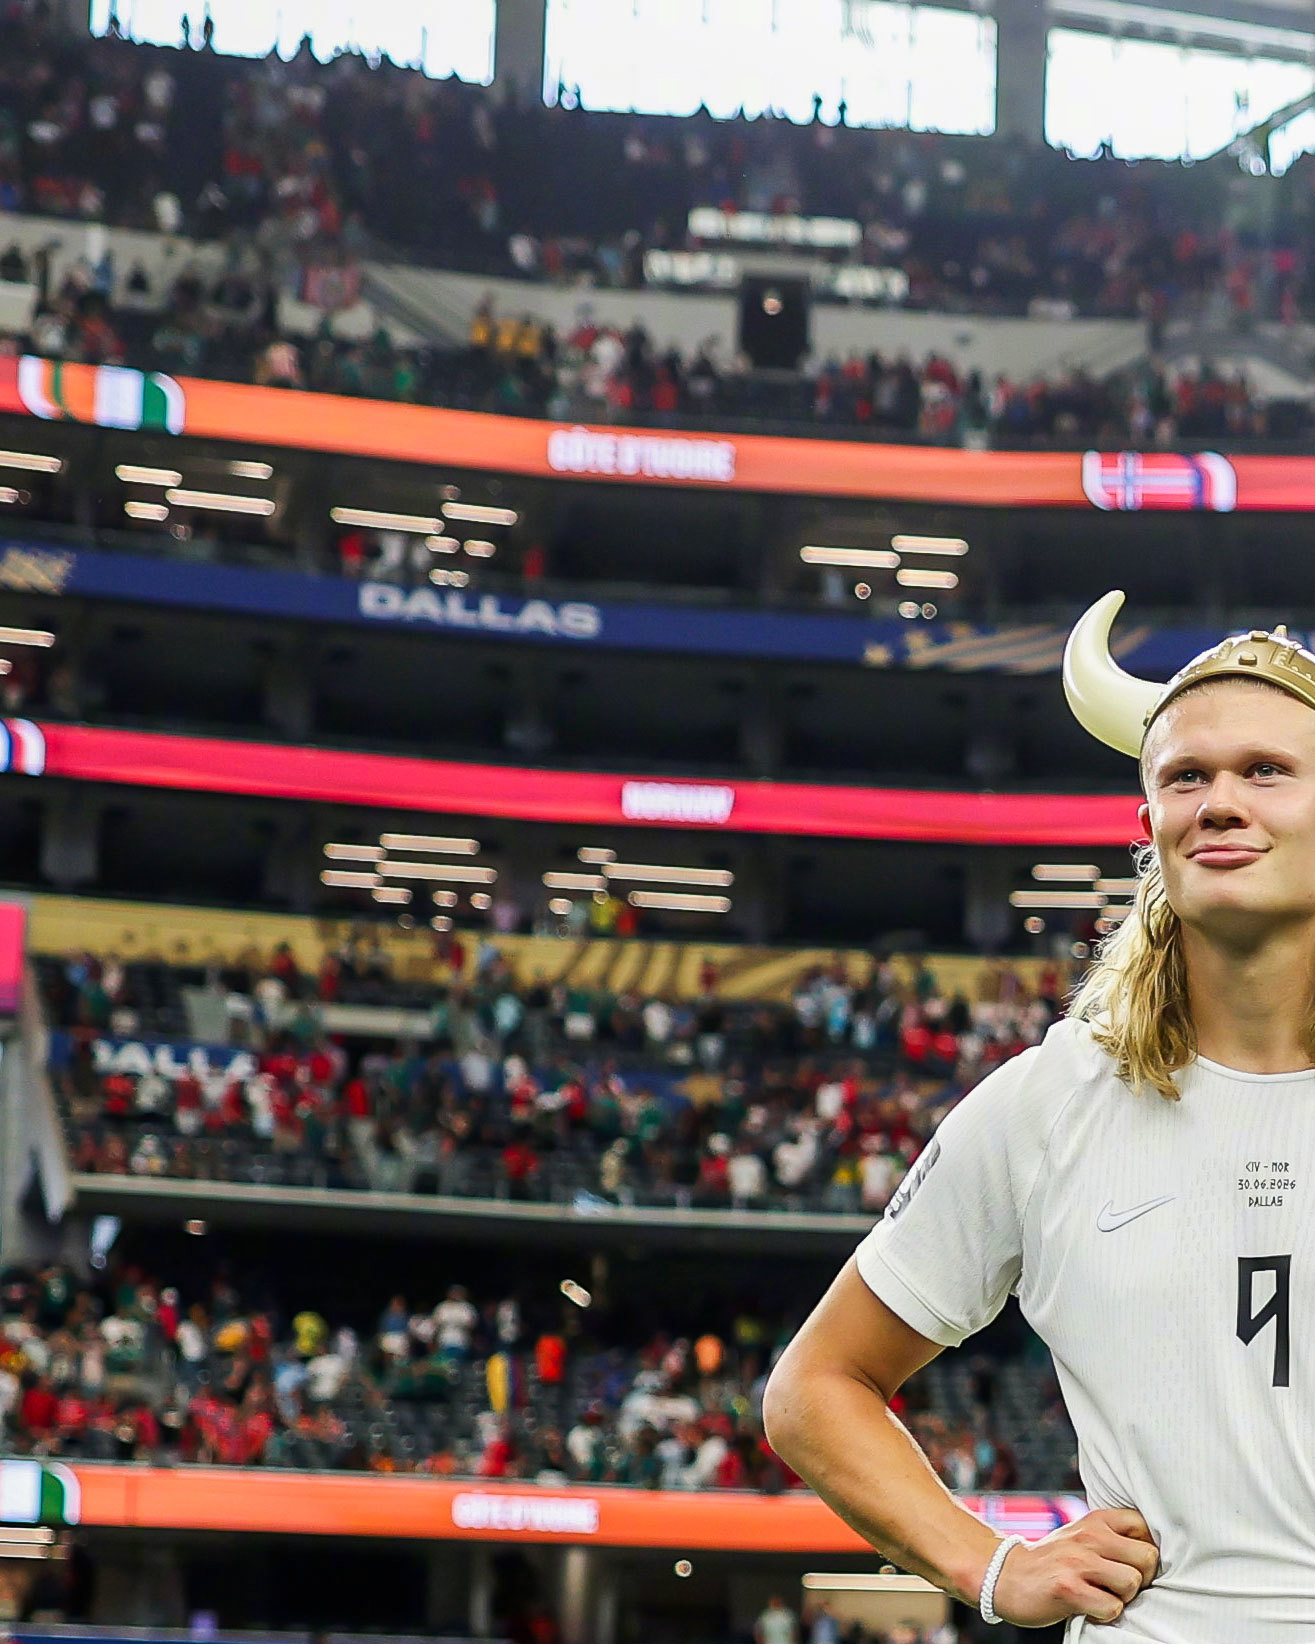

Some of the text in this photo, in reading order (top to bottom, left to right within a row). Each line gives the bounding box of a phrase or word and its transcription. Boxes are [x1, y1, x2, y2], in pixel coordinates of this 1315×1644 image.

[358, 581, 601, 639] DALLAS
[1245, 1161, 1260, 1172] CIV
[1271, 1161, 1289, 1172] NOR
[1238, 1178, 1296, 1190] 30.06.2026
[1248, 1195, 1283, 1207] DALLAS
[1236, 1254, 1292, 1387] 9
